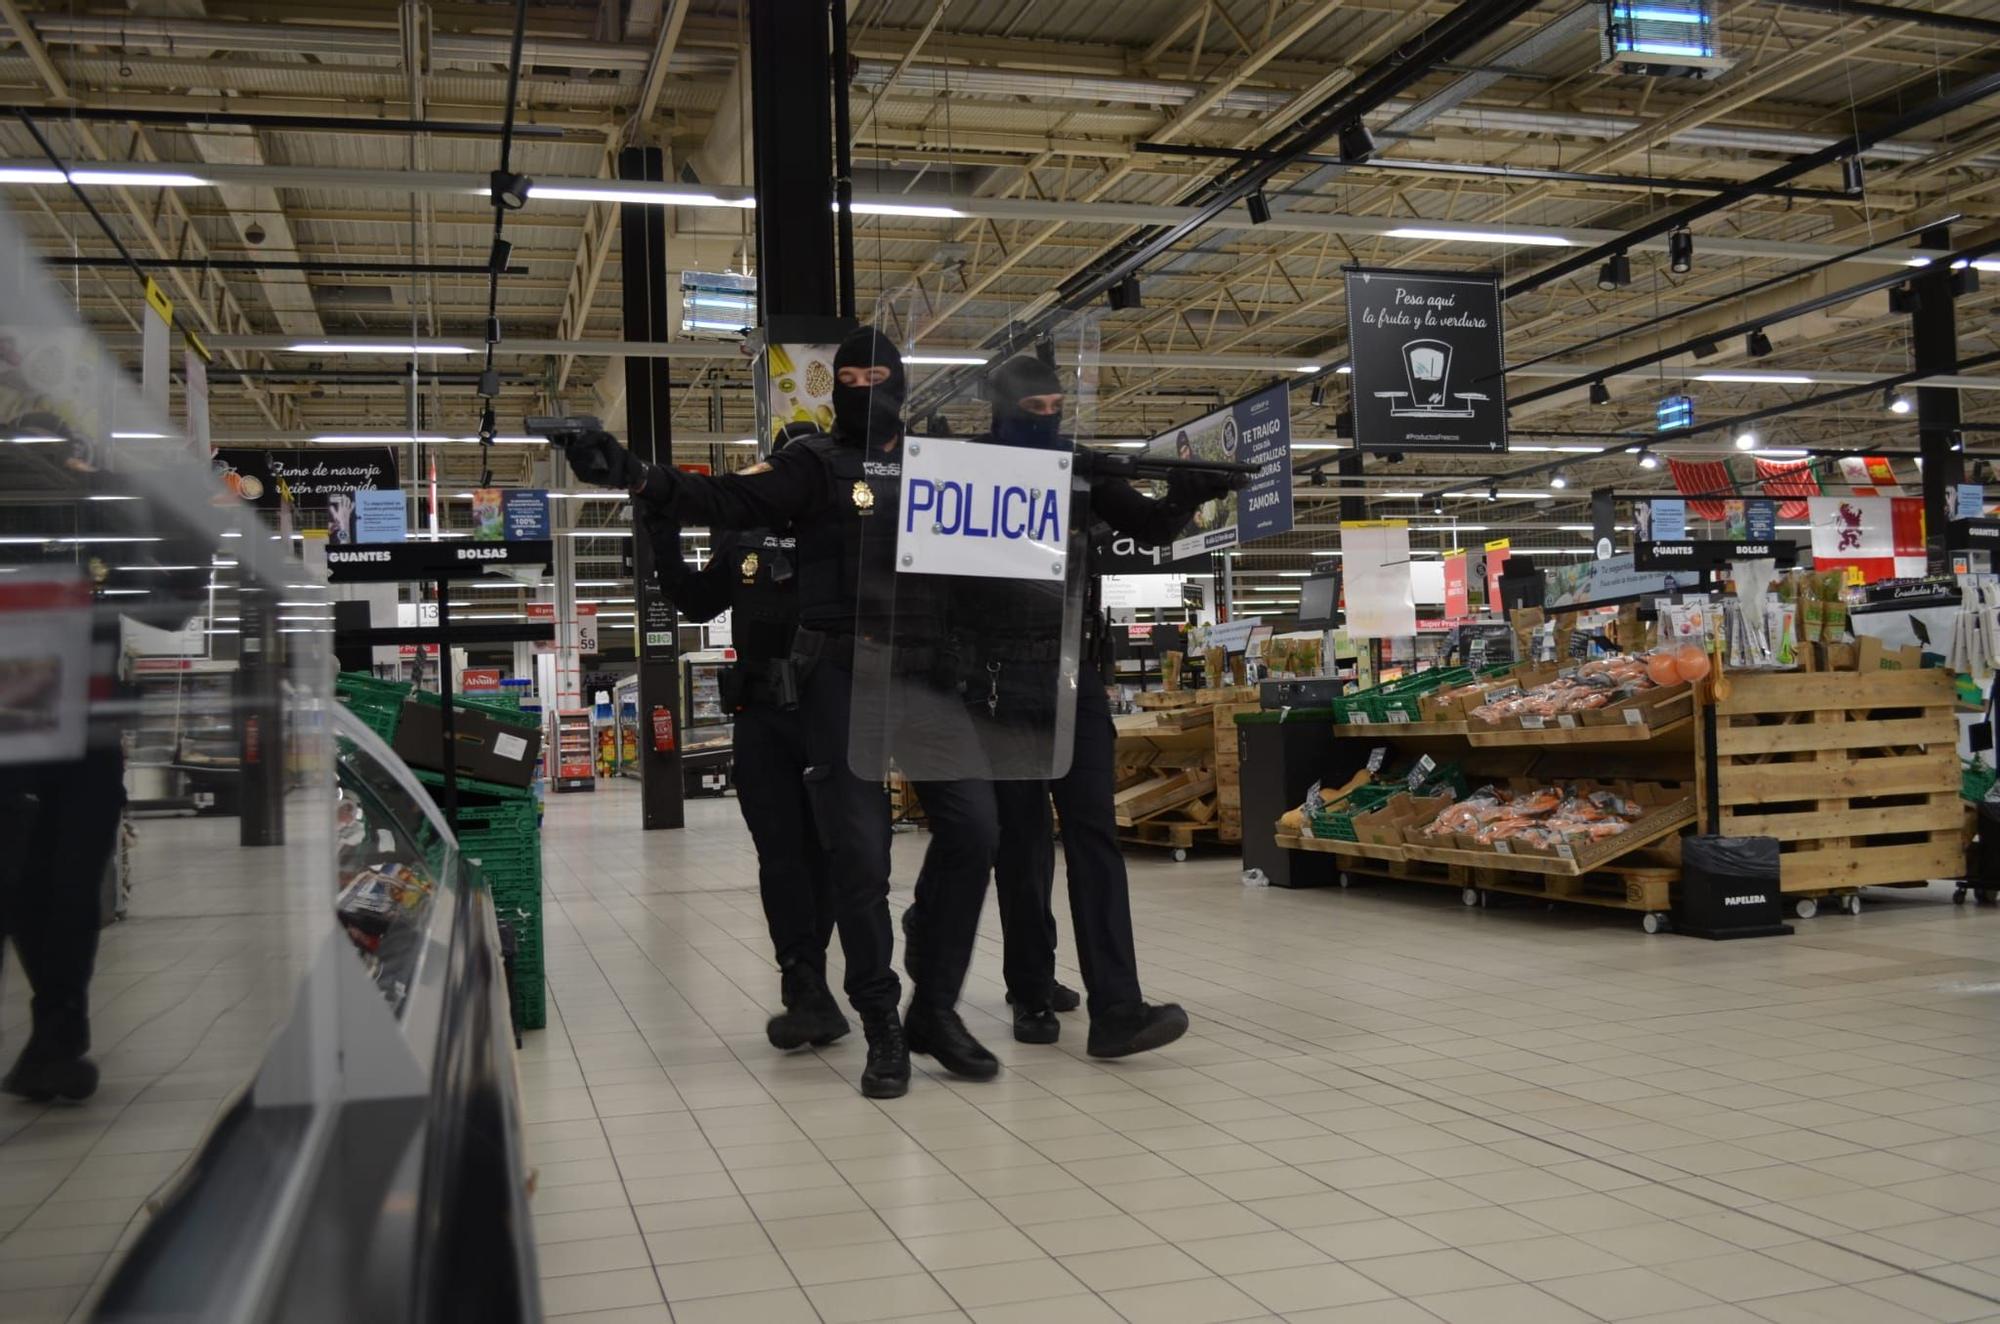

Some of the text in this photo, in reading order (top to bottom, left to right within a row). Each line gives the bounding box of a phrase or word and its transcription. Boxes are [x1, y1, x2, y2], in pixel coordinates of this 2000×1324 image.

[1395, 288, 1456, 311] Pesa aquí
[1362, 306, 1488, 330] la fruta y la verdura
[1242, 430, 1253, 444] TE
[1252, 418, 1281, 442] TRAIGO
[1250, 445, 1287, 464] HORTALIZAS
[312, 461, 329, 477] de
[332, 462, 382, 479] naranja
[275, 481, 313, 495] rcién
[1248, 490, 1280, 511] ZAMORA
[907, 478, 1060, 542] POLICIA
[329, 551, 392, 562] GUANTES
[457, 548, 508, 559] BOLSAS
[1736, 545, 1769, 555] BOLSAS
[421, 604, 439, 619] 13
[580, 627, 588, 638] €
[648, 633, 672, 644] BIO
[580, 639, 595, 650] 59
[1724, 895, 1767, 906] PAPELERA
